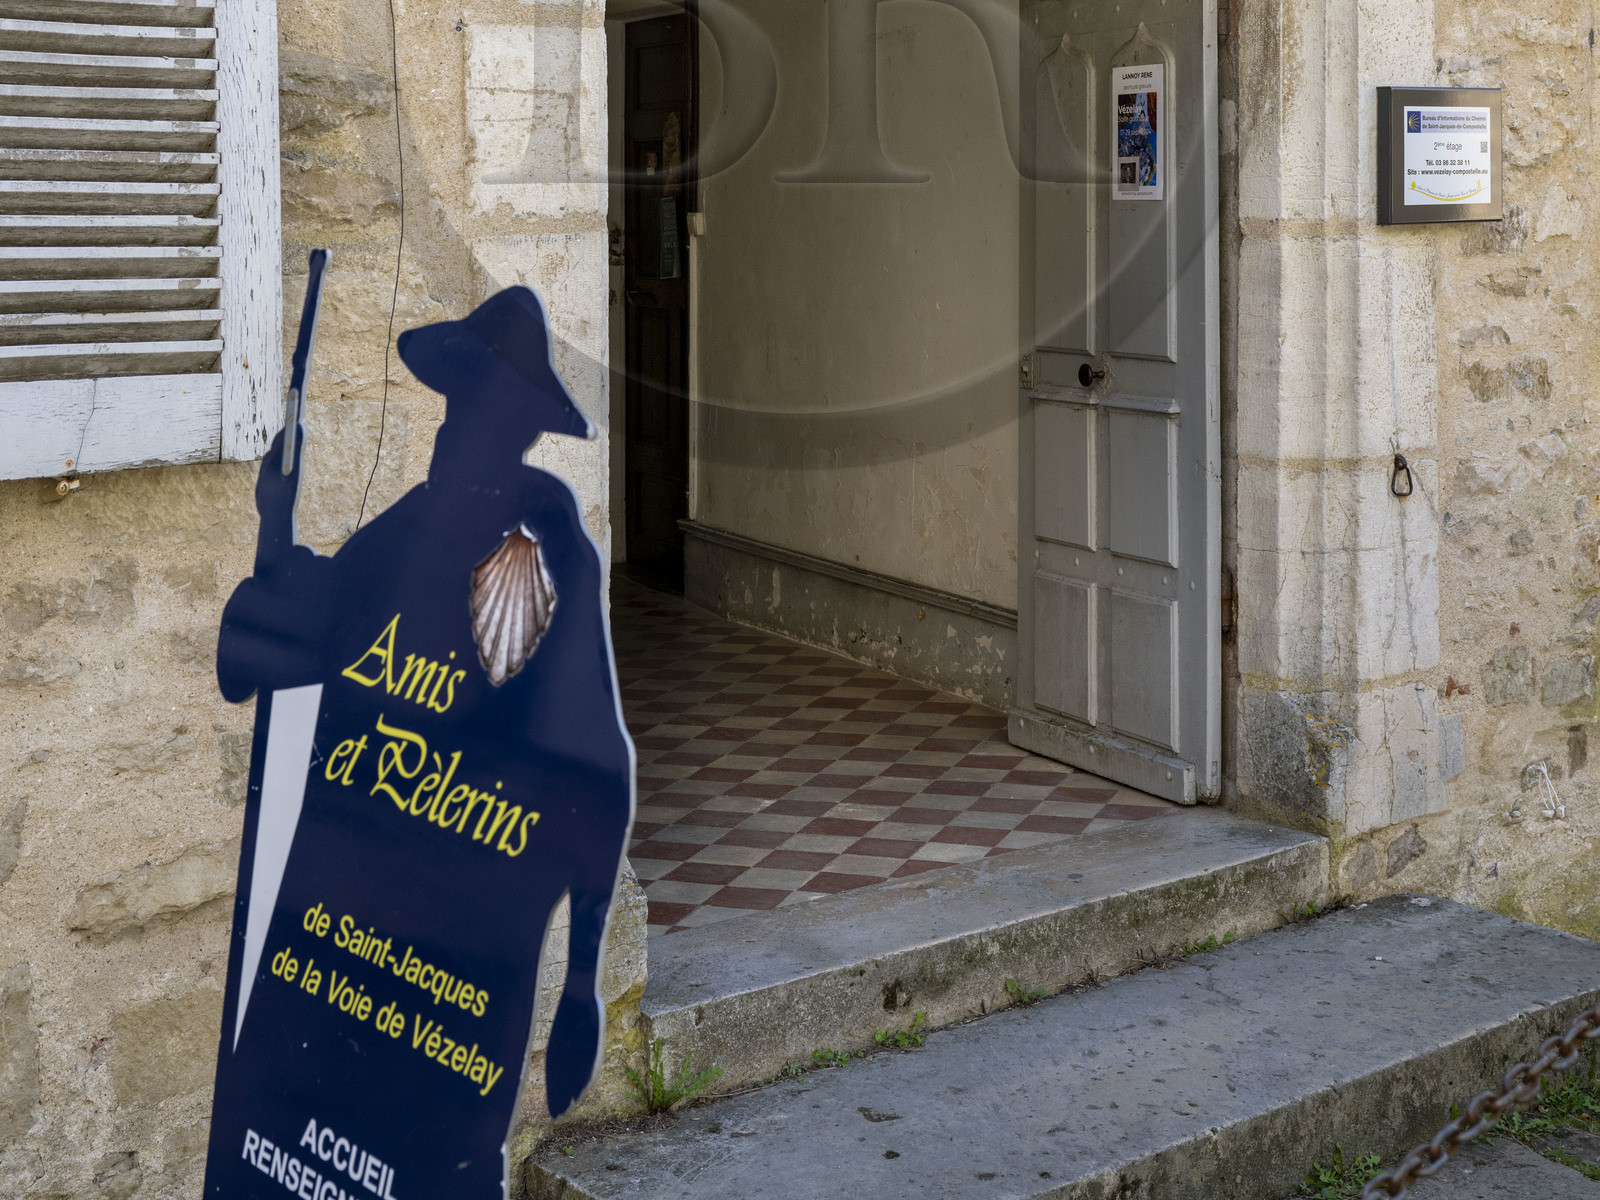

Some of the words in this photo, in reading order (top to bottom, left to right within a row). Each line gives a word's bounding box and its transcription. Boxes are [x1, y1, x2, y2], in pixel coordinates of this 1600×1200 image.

[1118, 104, 1143, 115] Vézelay
[1122, 72, 1140, 80] LANNOY
[1407, 168, 1417, 176] Site
[1421, 168, 1488, 176] www.vezelay-compostelle.eu
[1446, 141, 1463, 152] étage
[342, 613, 466, 713] Amis
[324, 734, 368, 786] et
[370, 713, 541, 857] Pèlerins
[303, 902, 331, 937] de
[334, 915, 489, 1017] Saint-Jacques
[271, 947, 299, 982] de
[300, 959, 322, 995] la
[328, 970, 372, 1021] Voie
[375, 1001, 405, 1038] de
[412, 1013, 504, 1096] Vézelay
[299, 1117, 398, 1200] ACCUEIL
